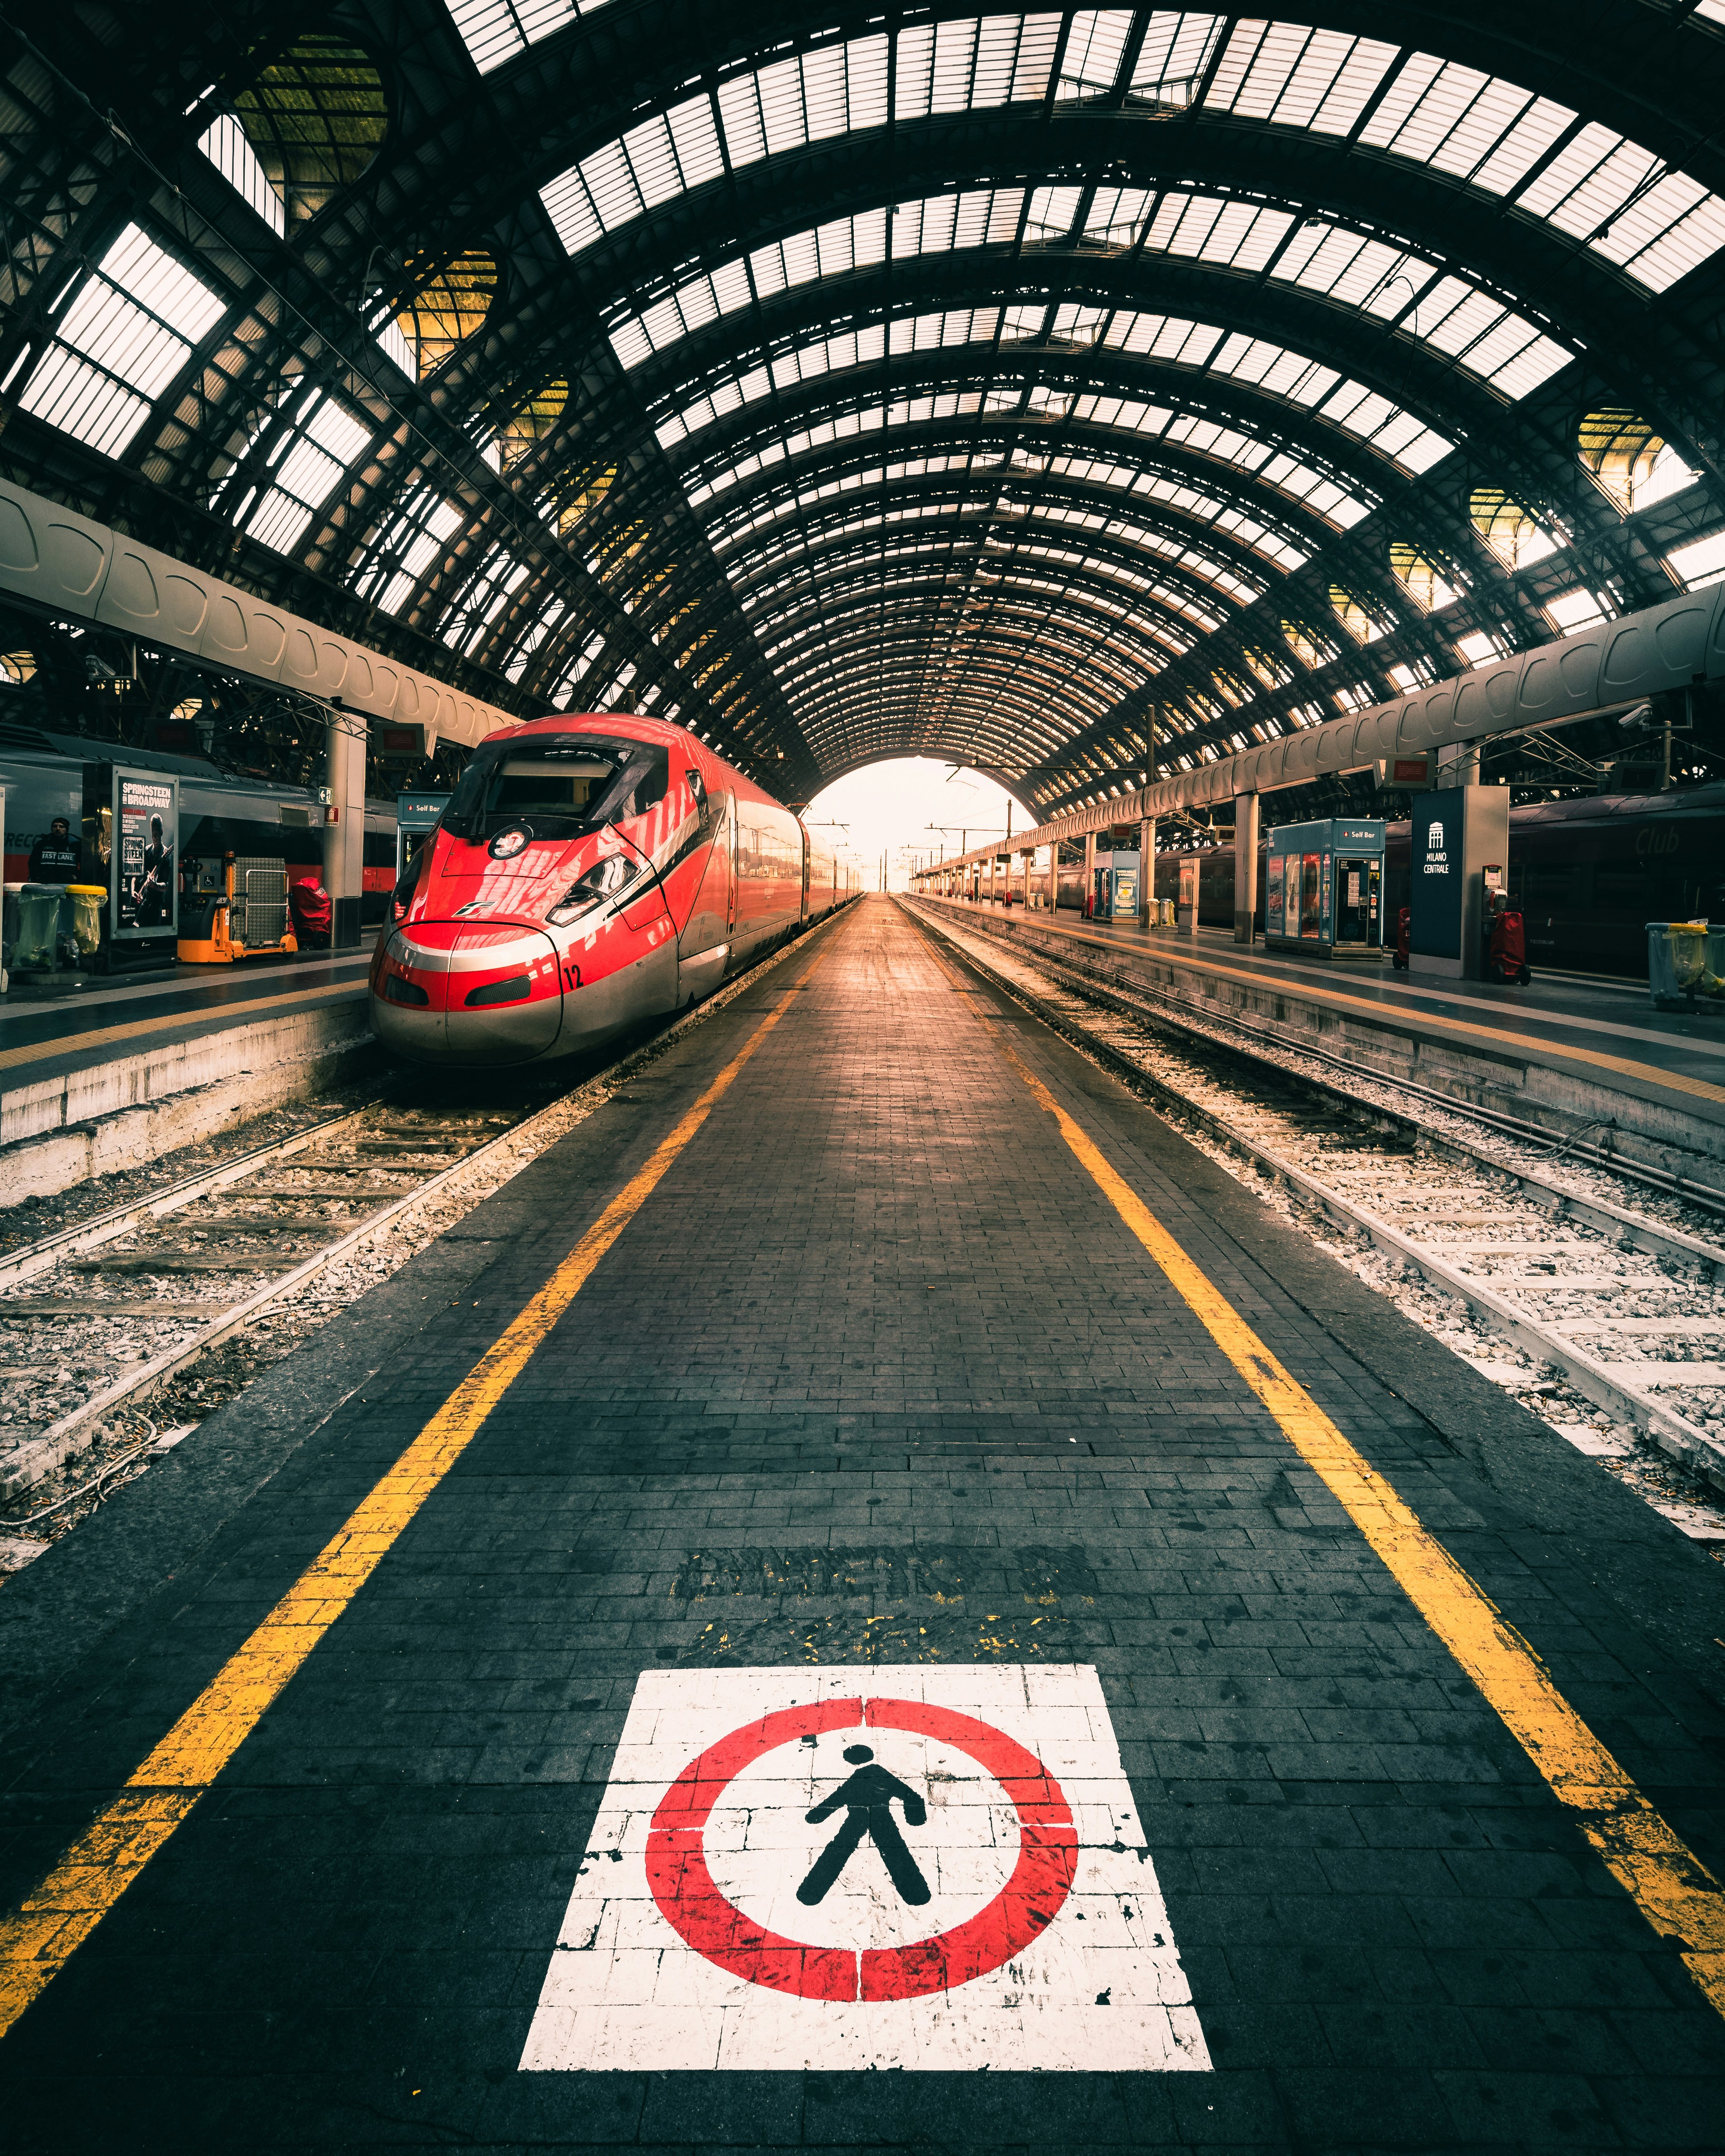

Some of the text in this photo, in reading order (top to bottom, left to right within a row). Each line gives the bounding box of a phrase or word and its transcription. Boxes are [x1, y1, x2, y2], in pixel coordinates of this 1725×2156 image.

[123, 782, 171, 798] SPRINGSTEEN
[127, 794, 171, 809] BROADWAY
[4, 832, 43, 847] RECC
[124, 839, 143, 849] SPRING
[1636, 826, 1679, 854] Club
[124, 849, 143, 859] STEEN
[1426, 852, 1447, 861] MILANO
[1424, 864, 1449, 873] CENTRALE
[564, 965, 584, 989] 12
